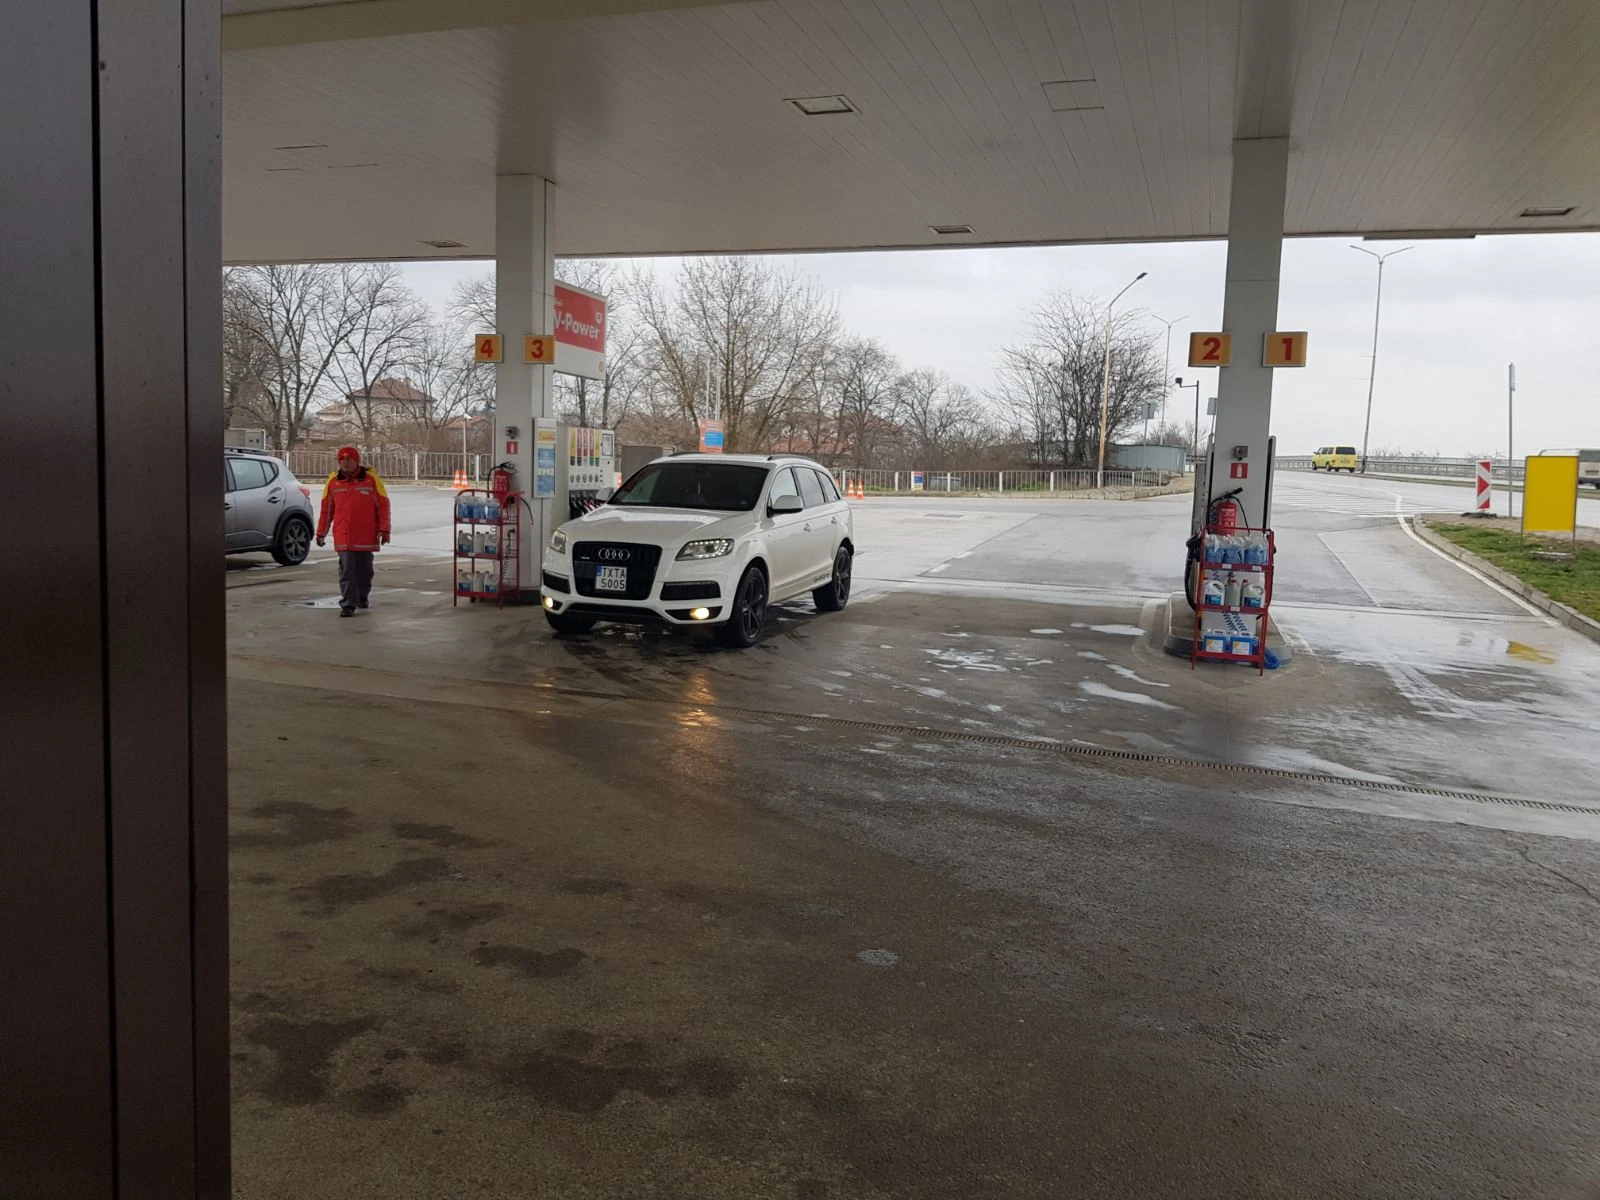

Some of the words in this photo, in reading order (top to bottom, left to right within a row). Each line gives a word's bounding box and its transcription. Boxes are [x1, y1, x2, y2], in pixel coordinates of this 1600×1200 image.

[554, 309, 599, 339] V-Power
[481, 339, 494, 358] 4
[531, 339, 544, 358] 3
[1202, 337, 1220, 360] 2
[1282, 338, 1293, 360] 1
[602, 568, 625, 578] TXTA
[601, 579, 625, 589] 5005
